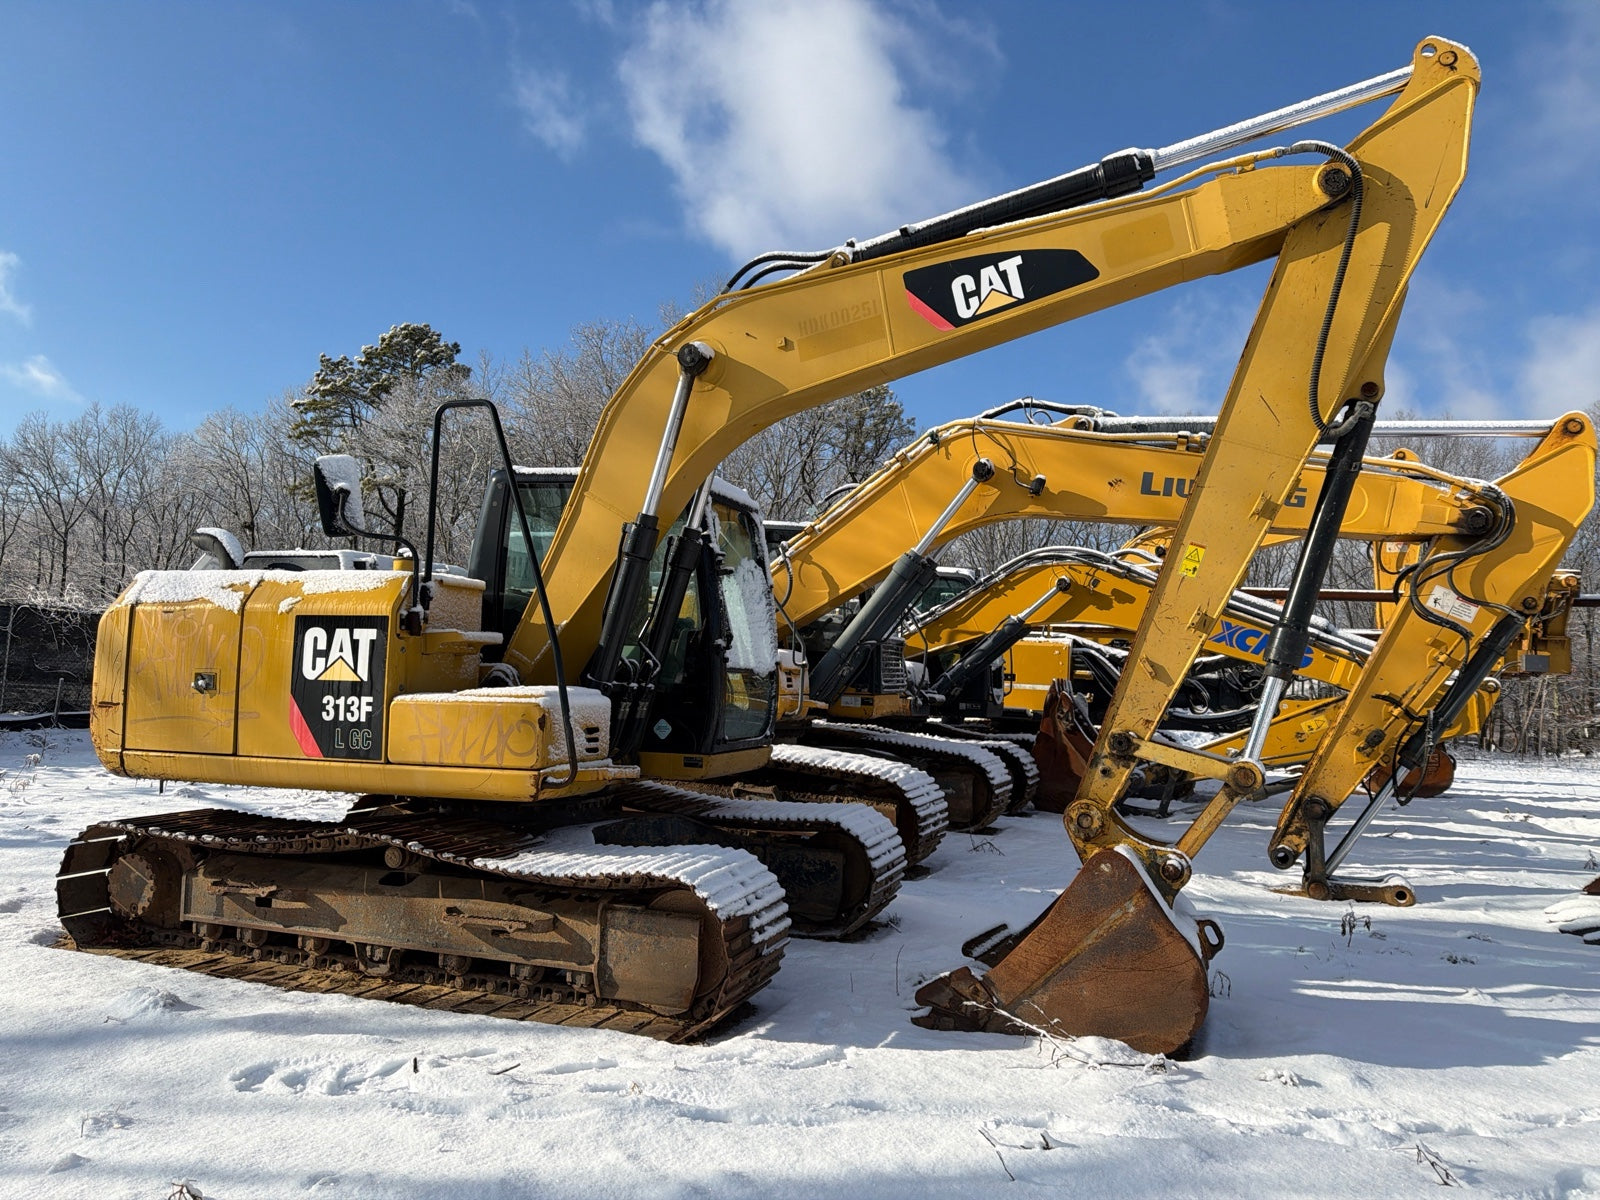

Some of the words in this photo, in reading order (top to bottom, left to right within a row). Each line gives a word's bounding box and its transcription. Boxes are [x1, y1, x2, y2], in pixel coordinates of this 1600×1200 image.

[951, 254, 1025, 319] CAT
[1141, 471, 1307, 508] LIUG
[302, 626, 377, 682] CAT
[321, 695, 374, 722] 313F
[334, 728, 344, 749] L
[349, 728, 372, 750] GC
